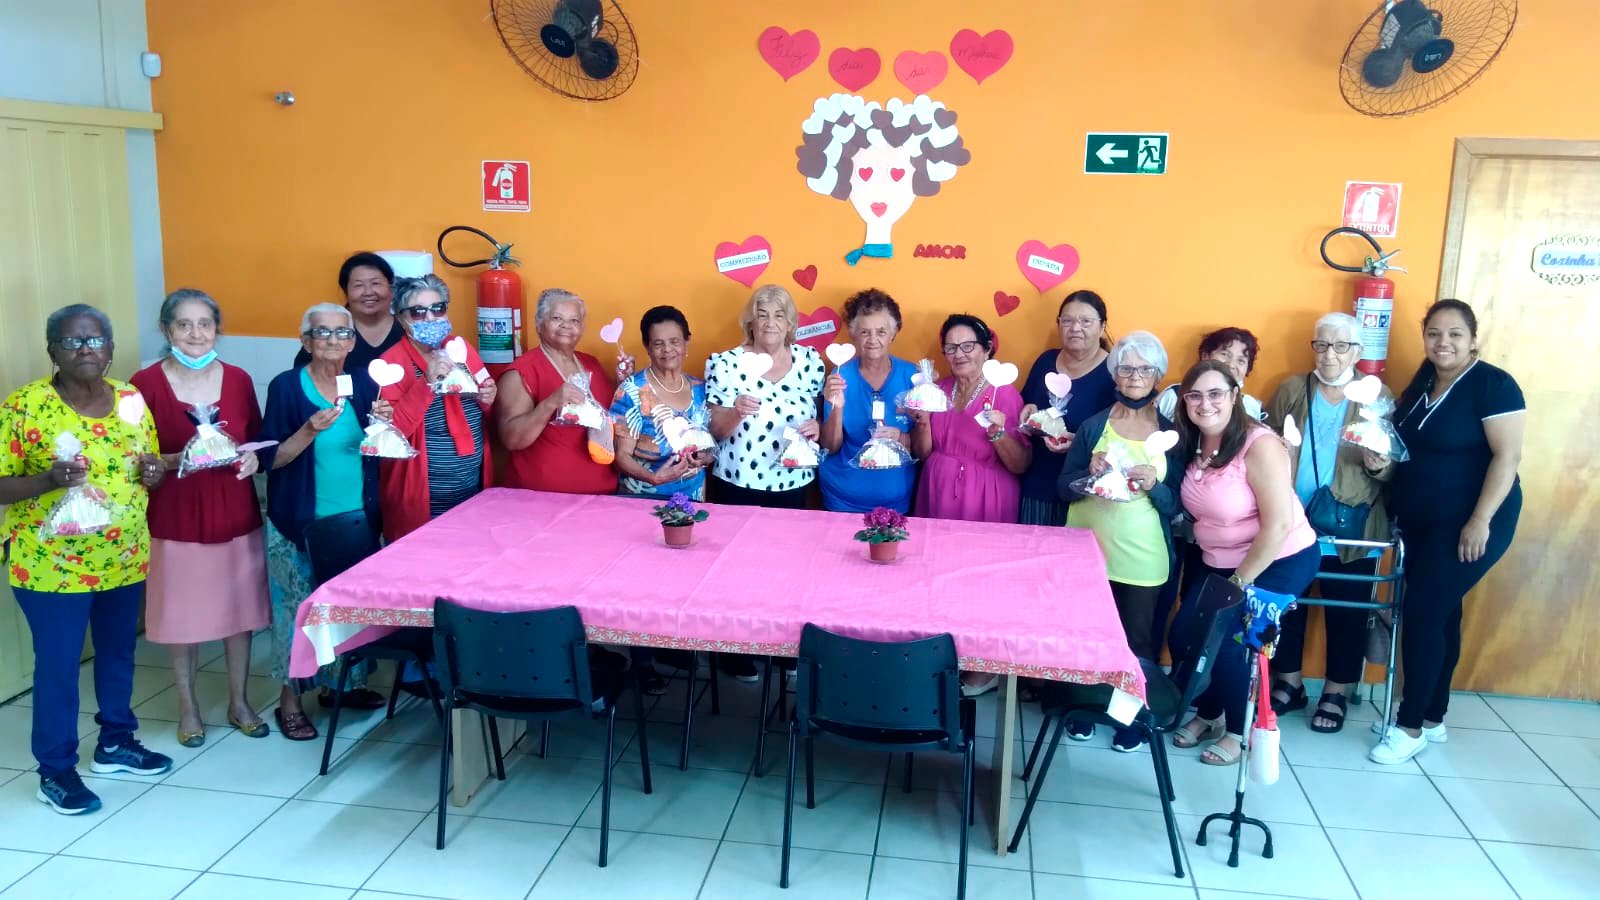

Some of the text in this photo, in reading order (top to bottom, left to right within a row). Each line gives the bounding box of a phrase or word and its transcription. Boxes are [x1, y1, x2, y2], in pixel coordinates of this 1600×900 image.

[913, 243, 966, 260] AMOR
[1540, 253, 1596, 266] Cozinha
[796, 323, 832, 337] OLERÂNCIA
